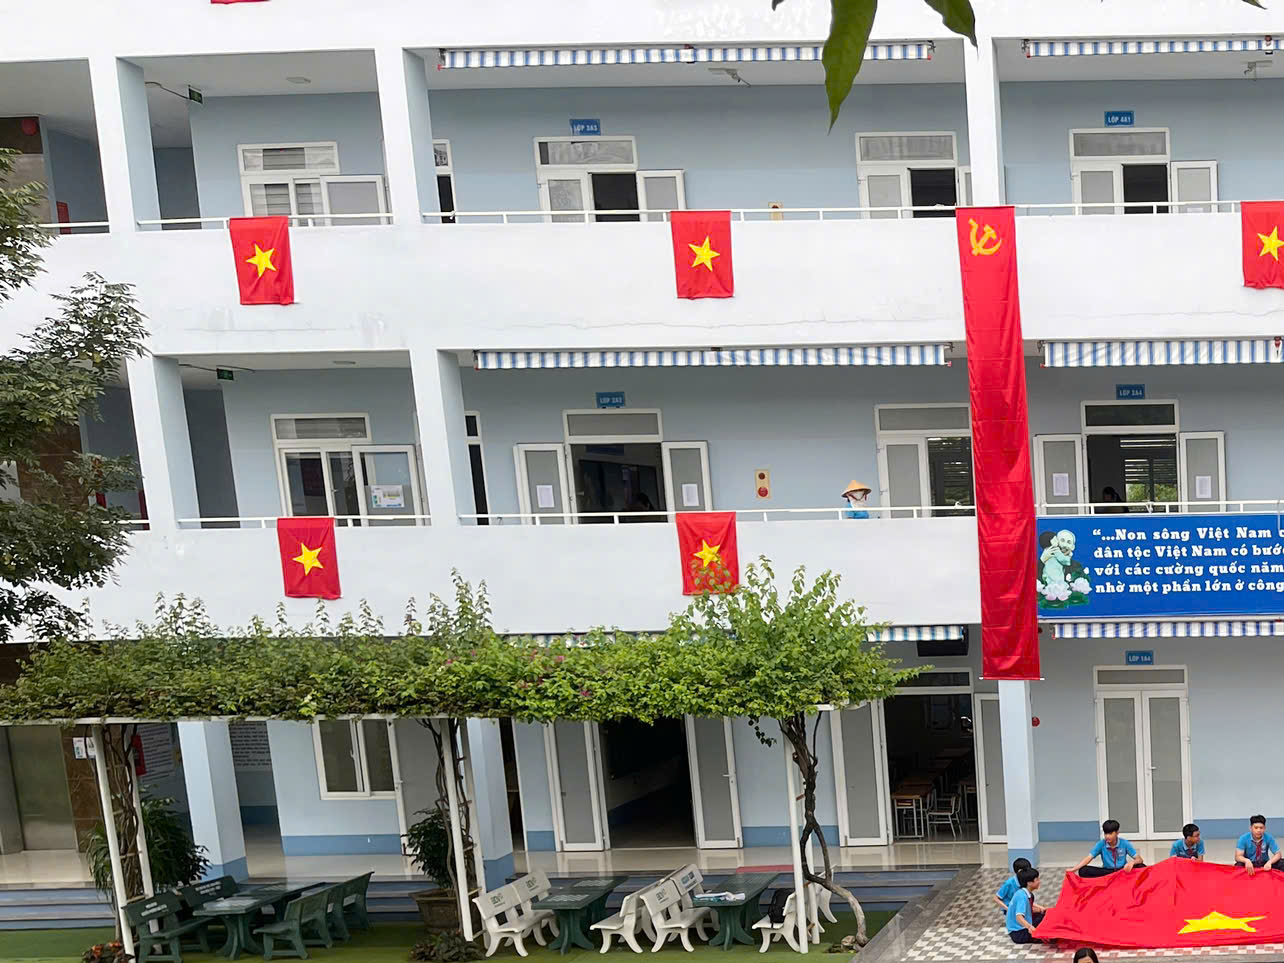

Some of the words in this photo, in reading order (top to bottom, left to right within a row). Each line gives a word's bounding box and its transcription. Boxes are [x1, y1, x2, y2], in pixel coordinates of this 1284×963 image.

[1153, 528, 1189, 541] sông
[1197, 527, 1229, 541] Việt
[1237, 527, 1271, 538] Nam
[1094, 547, 1123, 558] dân
[1127, 546, 1150, 560] tộc
[1155, 546, 1187, 559] Việt
[1192, 546, 1227, 556] Nam
[1231, 544, 1247, 555] có
[1094, 564, 1120, 575] với
[1125, 563, 1150, 575] các
[1156, 563, 1203, 576] cường
[1209, 561, 1245, 575] quốc
[1251, 562, 1284, 573] năm
[1096, 581, 1125, 592] nhờ
[1129, 581, 1158, 594] một
[1162, 579, 1197, 594] phần
[1205, 579, 1231, 591] lớn
[1235, 579, 1244, 590] ở
[1248, 579, 1284, 592] công
